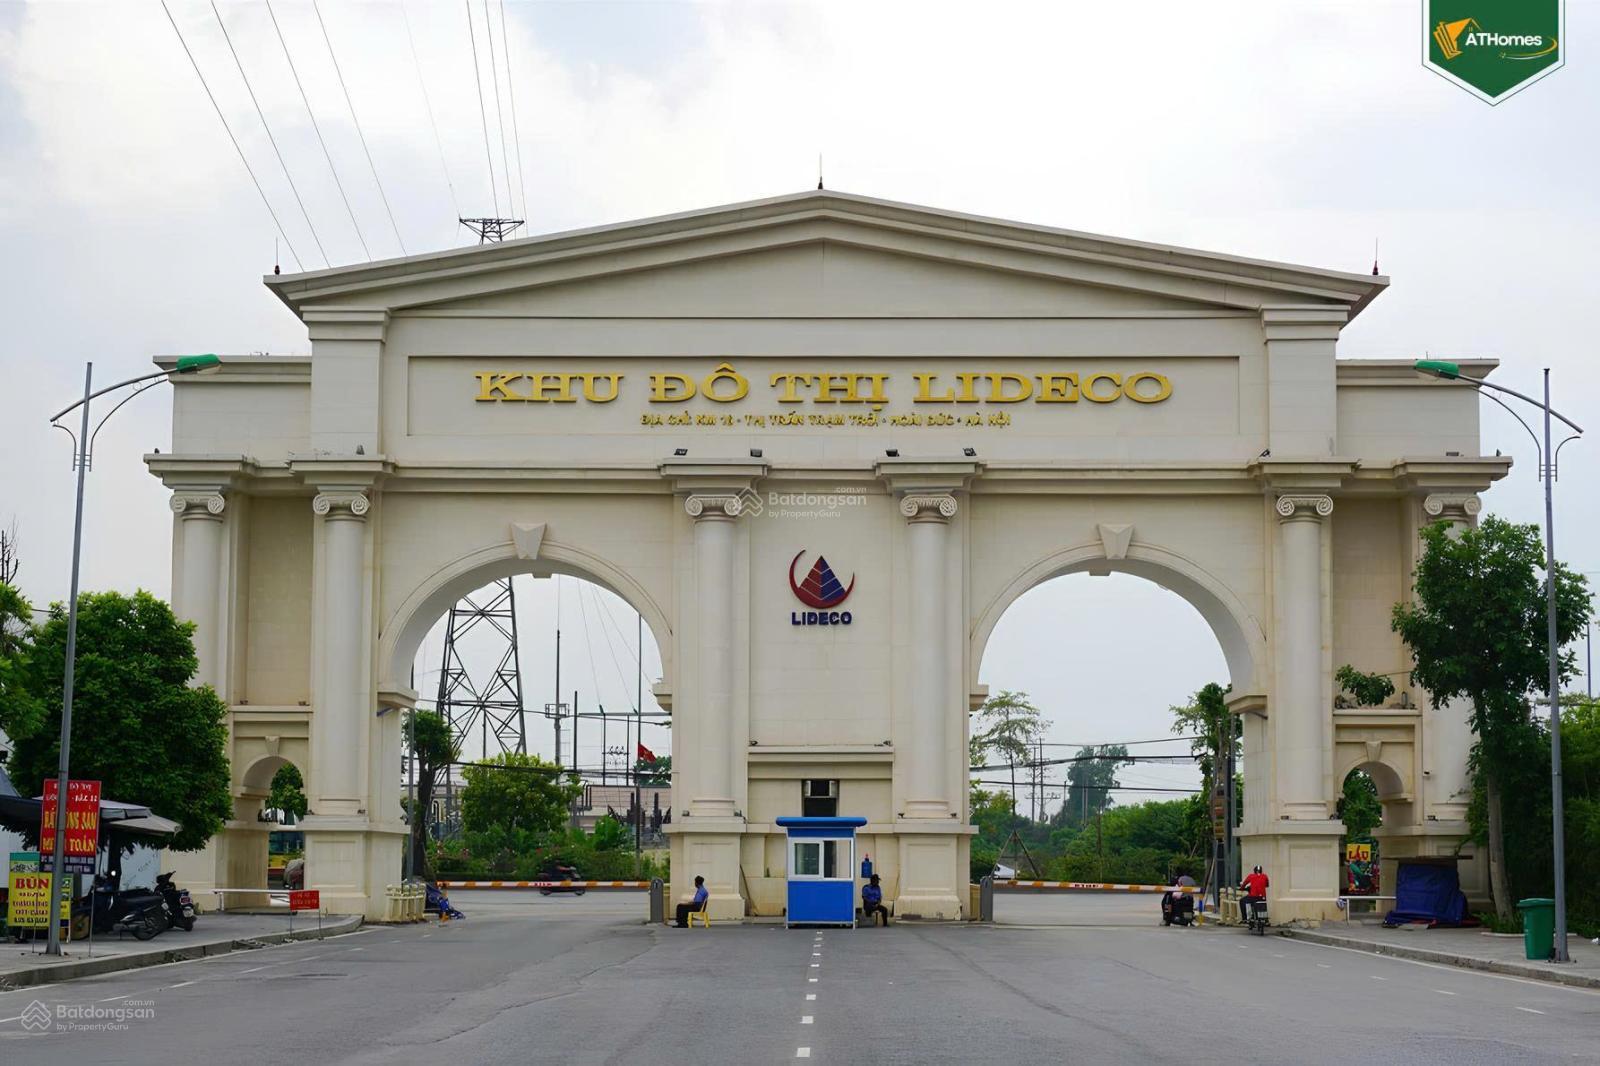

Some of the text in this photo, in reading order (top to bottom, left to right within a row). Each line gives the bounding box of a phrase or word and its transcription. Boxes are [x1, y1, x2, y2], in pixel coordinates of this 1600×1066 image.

[474, 361, 1174, 411] KHU ĐÔ THỊ LIDECO
[791, 611, 853, 626] LIDECO
